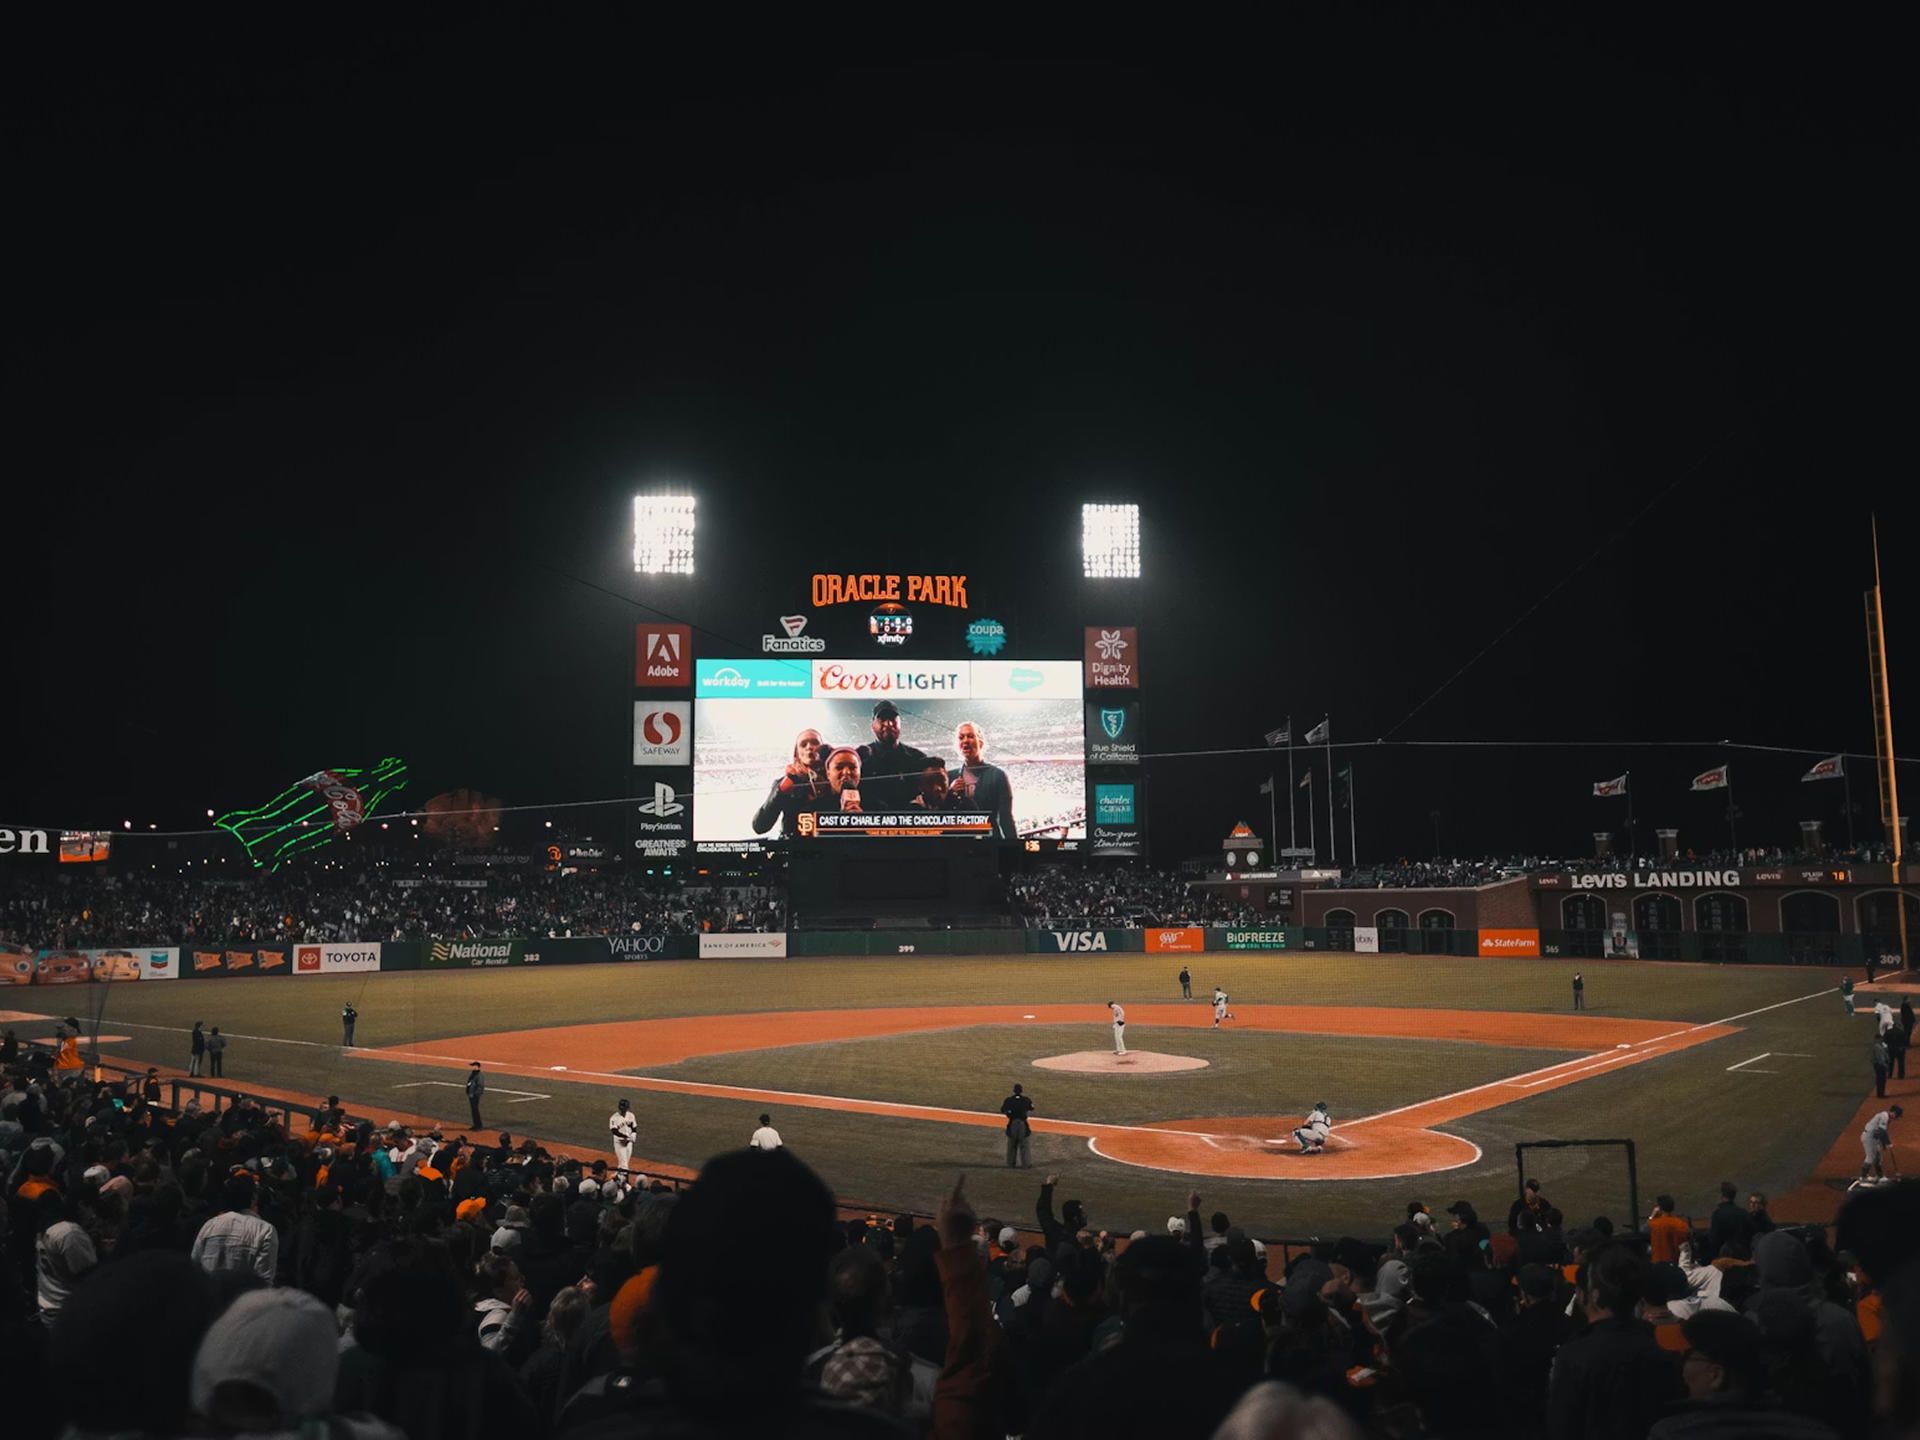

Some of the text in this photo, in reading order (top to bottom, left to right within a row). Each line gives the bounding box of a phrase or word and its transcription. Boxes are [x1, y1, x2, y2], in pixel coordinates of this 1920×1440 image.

[812, 574, 969, 608] ORACLE PARK
[969, 625, 1004, 637] coupa
[764, 635, 826, 652] Fanatics
[877, 633, 905, 645] xfinity
[648, 665, 681, 676] Adobe
[1092, 662, 1131, 676] Dignity
[703, 676, 751, 688] workday
[819, 664, 958, 691] Coors LIGHT
[1094, 673, 1130, 685] Health
[642, 746, 681, 756] SAFEWAY
[1092, 743, 1136, 752] Blue Shield
[1099, 752, 1139, 761] California
[819, 814, 990, 827] CAST OF CHARLIE AND THE CHOCOLATE FACTORY
[640, 822, 683, 833] PlayStation
[0, 829, 50, 853] en
[635, 839, 687, 849] GREATNESS
[1634, 870, 1741, 888] LANDING
[608, 936, 665, 955] YAHOO!
[1051, 931, 1107, 951] VISA
[449, 943, 513, 959] National
[624, 953, 648, 961] SPORTS
[326, 952, 377, 963] TOYOTA
[485, 958, 509, 966] Rental
[1880, 954, 1902, 965] 309
